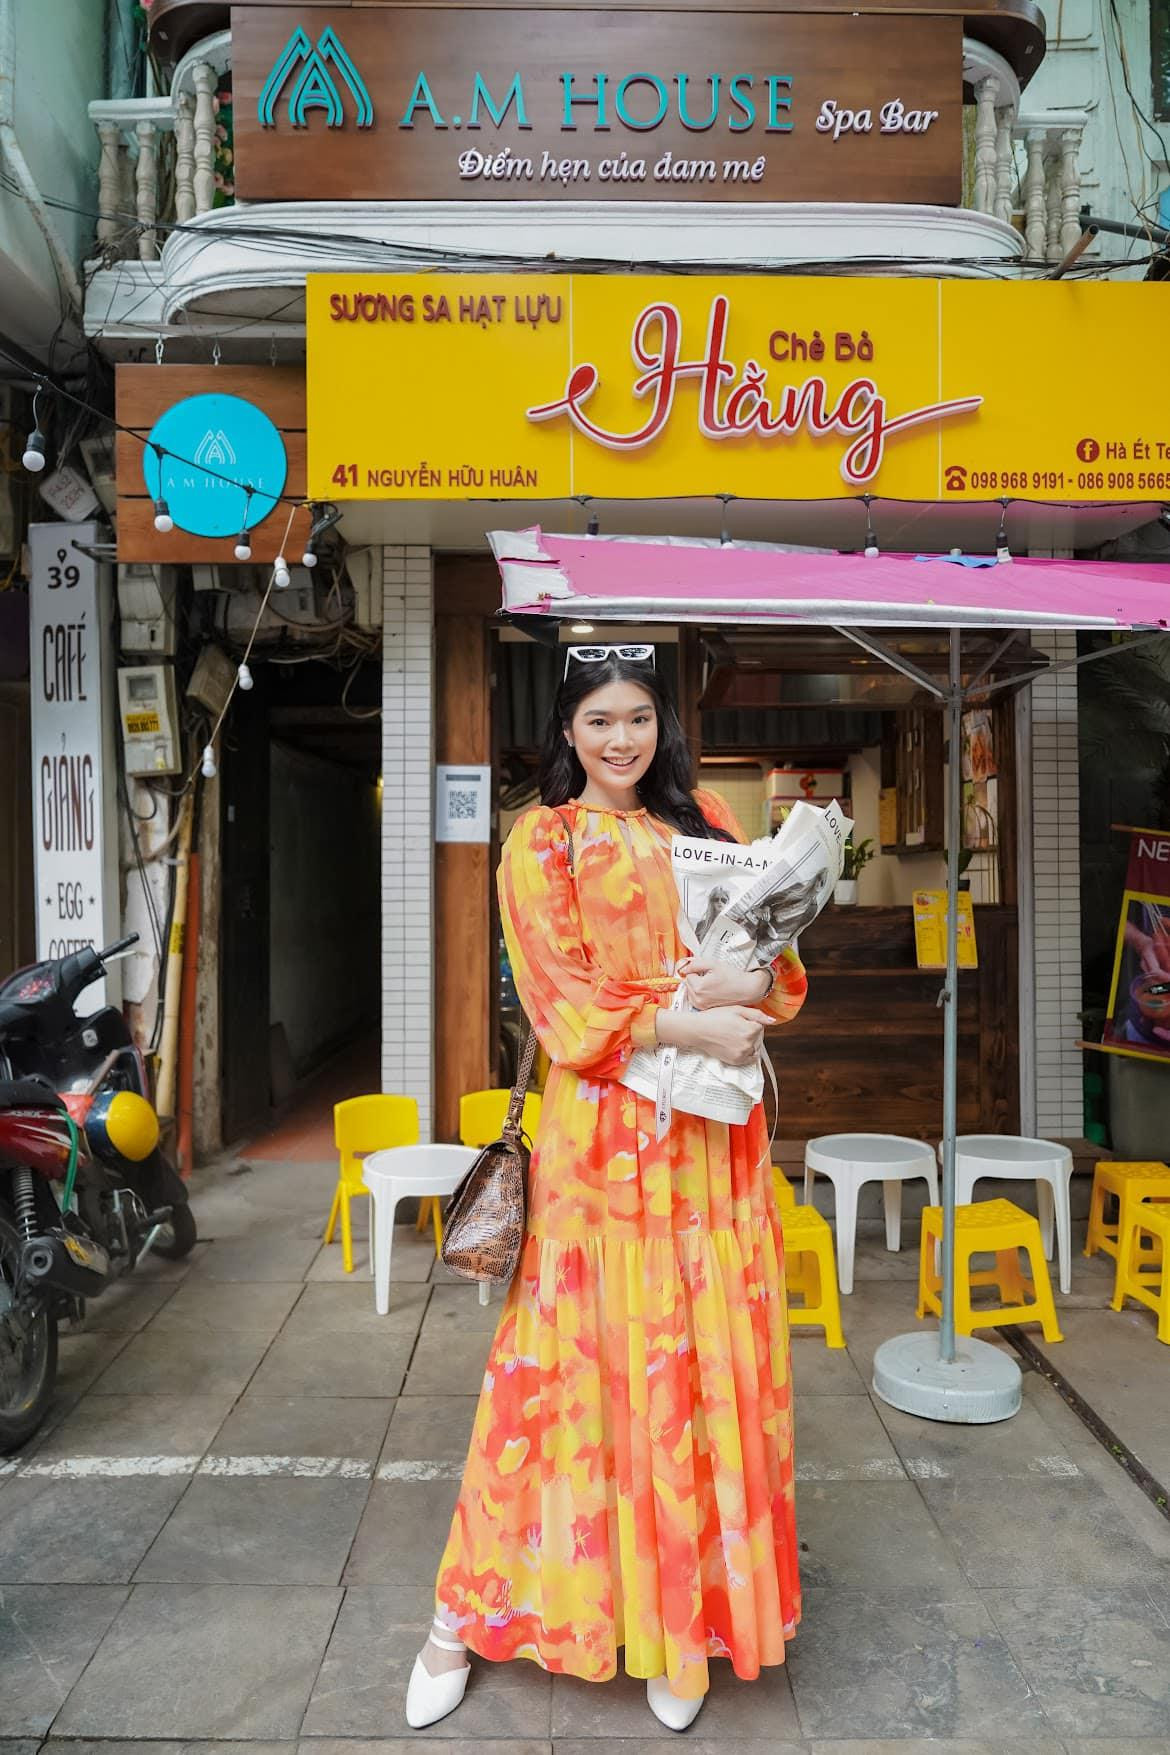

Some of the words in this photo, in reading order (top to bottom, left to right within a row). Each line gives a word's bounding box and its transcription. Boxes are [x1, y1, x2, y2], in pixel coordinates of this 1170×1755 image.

[400, 72, 533, 130] A.M
[559, 73, 795, 132] HOUSE
[816, 100, 872, 141] Spa
[879, 98, 939, 134] Bar
[457, 149, 534, 180] Điểm
[540, 151, 591, 187] hẹn
[598, 151, 646, 181] của
[654, 151, 716, 181] đam
[722, 156, 766, 181] mê
[330, 292, 414, 323] SƯƠNG
[422, 294, 451, 323] SA
[459, 295, 506, 330] HẠT
[515, 293, 562, 330] LỰU
[769, 328, 825, 361] Chè
[835, 329, 873, 361] Bà
[525, 294, 984, 486] Hằng
[1106, 441, 1127, 459] Hà
[1133, 438, 1150, 459] Ét
[332, 463, 359, 488] 41
[367, 461, 441, 488] NGUYỄN
[449, 465, 483, 488] HỮU
[490, 465, 537, 488] HUÂN
[971, 472, 998, 489] 098
[1001, 472, 1028, 489] 968
[1032, 472, 1064, 489] 9191
[1078, 472, 1104, 489] 086
[1108, 472, 1134, 489] 908
[47, 566, 80, 589] 39
[42, 611, 87, 702] CAFÉ
[824, 810, 843, 844] LOVE
[58, 883, 84, 919] EGG
